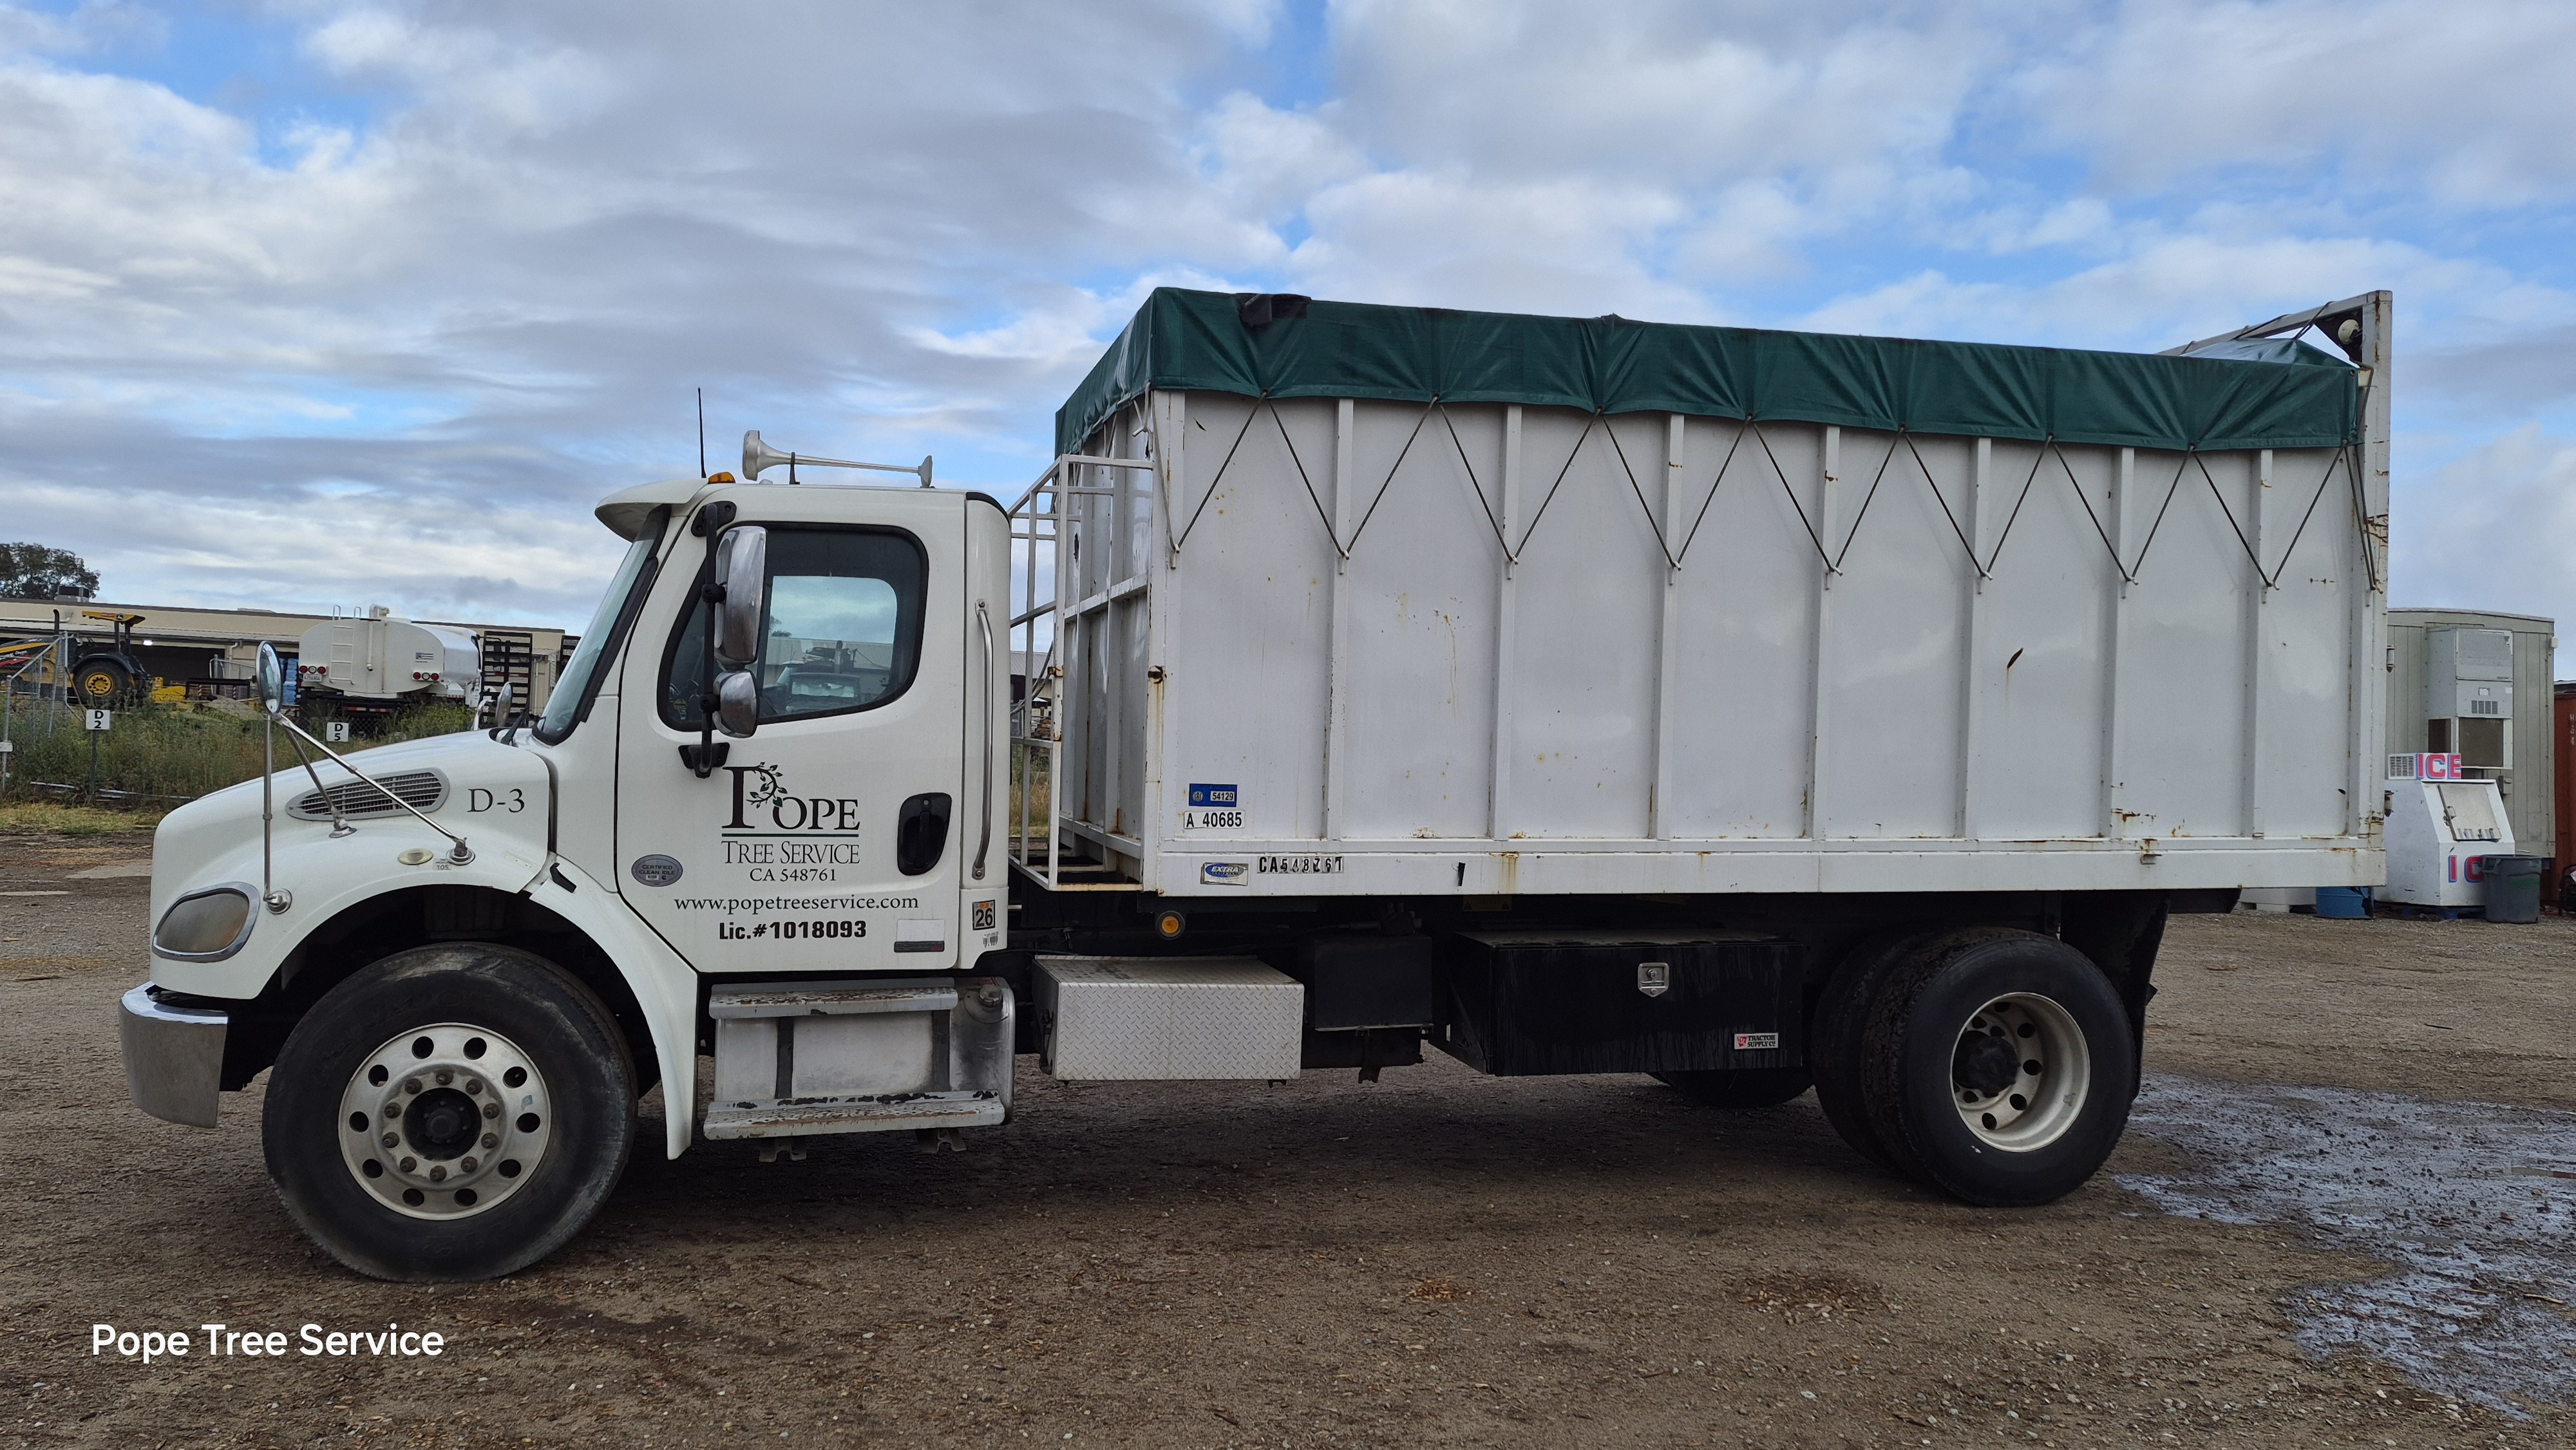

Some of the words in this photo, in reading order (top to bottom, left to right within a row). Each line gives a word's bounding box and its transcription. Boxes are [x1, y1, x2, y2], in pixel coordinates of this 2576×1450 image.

[94, 710, 104, 719] D
[94, 720, 102, 729] 2
[334, 723, 343, 731] D
[2416, 753, 2461, 780] ICE
[467, 788, 526, 813] D-3
[1211, 792, 1234, 801] 54129
[1186, 813, 1195, 828] A
[1202, 811, 1242, 827] 40685
[721, 840, 774, 864] TREE
[780, 840, 860, 864] SERVICE
[749, 868, 776, 881] CA
[780, 868, 837, 882] 548761
[674, 894, 919, 915] www.popetreeservice.com
[975, 909, 993, 927] 26
[719, 920, 867, 940] Lic.#1018093
